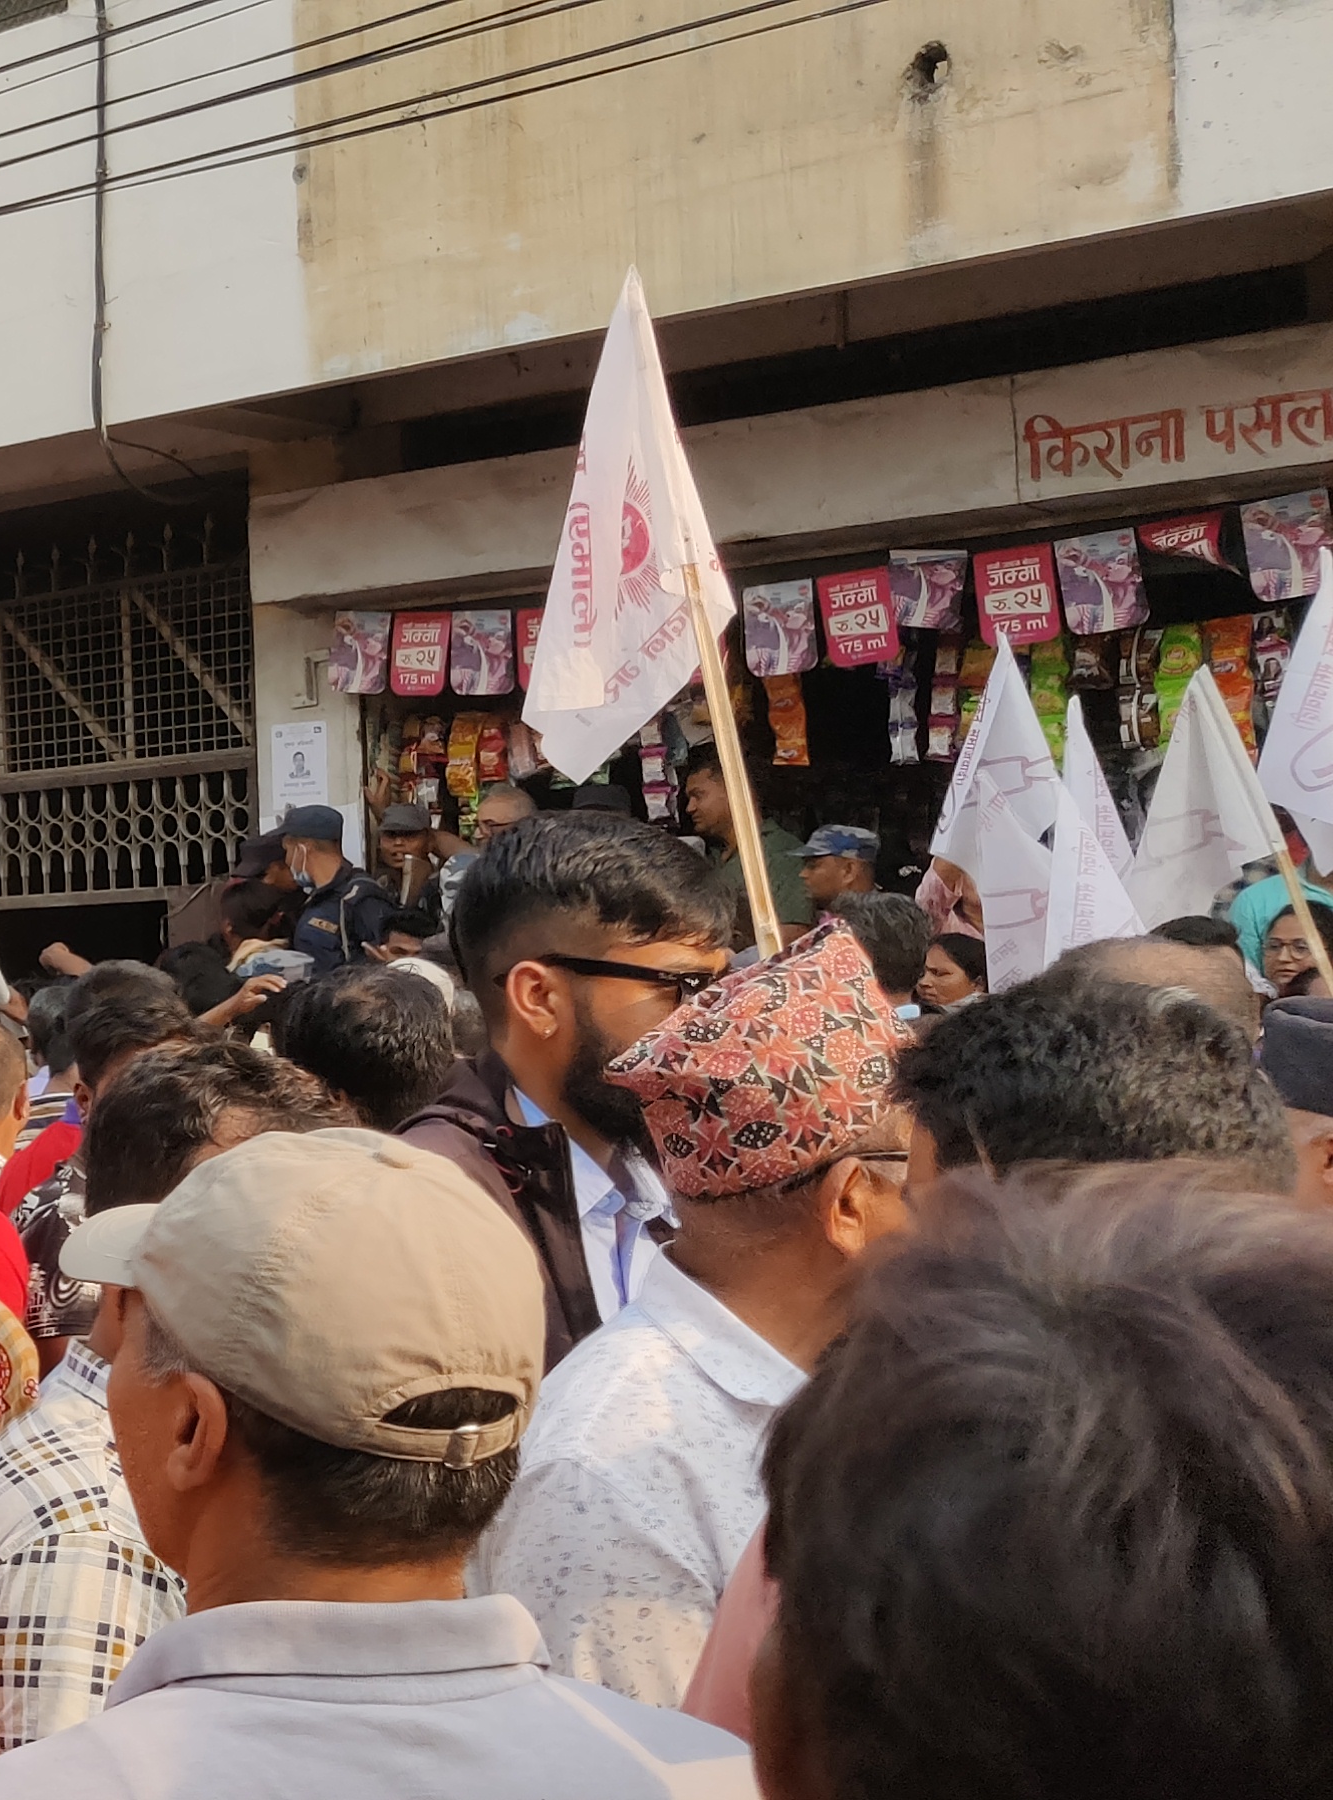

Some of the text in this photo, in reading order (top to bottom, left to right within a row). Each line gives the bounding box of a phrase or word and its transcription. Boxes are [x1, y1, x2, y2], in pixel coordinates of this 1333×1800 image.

[1023, 387, 1333, 482] किराना पसल
[986, 563, 1041, 587] जम्मा
[829, 585, 878, 609] जम्मा
[1014, 588, 1042, 609] २५
[854, 609, 881, 630] २५
[993, 614, 1049, 633] 175 ml
[401, 628, 441, 644] जम्मा
[838, 634, 888, 655] 175 ml
[415, 651, 437, 666] २५
[398, 673, 436, 685] 175 ml
